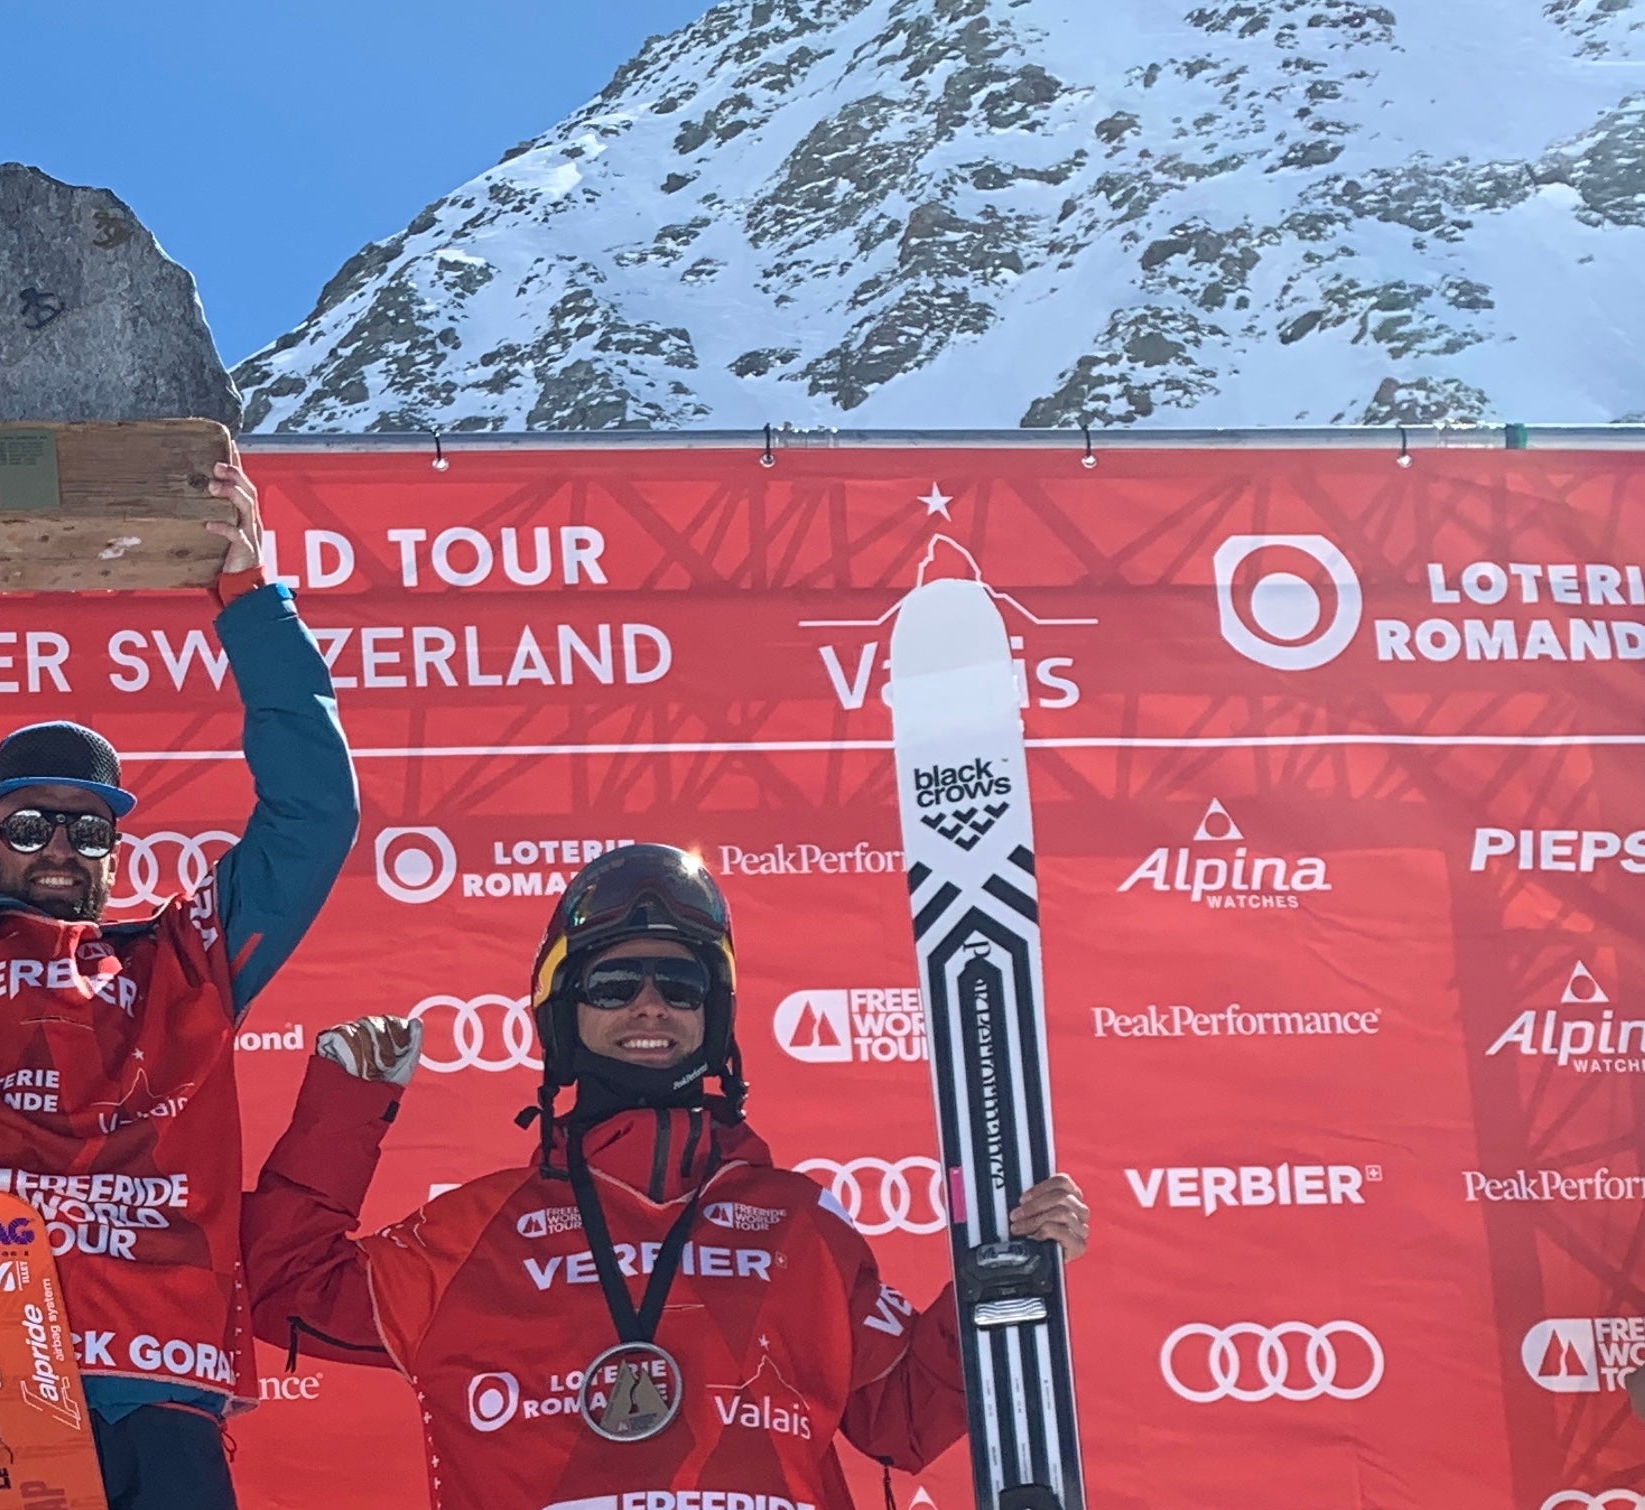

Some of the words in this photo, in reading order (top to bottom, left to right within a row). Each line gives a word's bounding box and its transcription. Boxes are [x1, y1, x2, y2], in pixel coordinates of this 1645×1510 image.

[387, 525, 608, 587] TOUR
[1427, 561, 1645, 605] LOTERI
[108, 624, 672, 692] SWZERLAND
[1374, 618, 1645, 662] ROMAND
[910, 754, 998, 790] black
[912, 771, 1015, 808] crows
[493, 839, 636, 866] LOTERI
[716, 836, 908, 879] PeakPerfor
[1470, 827, 1645, 874] PIEPS
[463, 872, 577, 899] ROMA
[1116, 847, 1332, 905] Alpina
[1206, 894, 1299, 909] WATCHES
[851, 988, 924, 1016] FREE
[851, 1013, 926, 1041] WOR
[1485, 1009, 1645, 1071] Alpin
[852, 1036, 928, 1062] TOU
[1572, 1058, 1645, 1073] WATCH
[16, 1169, 190, 1208] FREERIDE
[1124, 1162, 1365, 1217] VERBIER
[1461, 1167, 1645, 1202] PeakPerfor
[733, 1211, 781, 1226] WORLD
[733, 1219, 770, 1232] TOUR
[51, 1223, 139, 1261] OUR
[42, 1277, 59, 1322] system
[21, 1303, 60, 1402] alpride
[51, 1324, 65, 1362] airbag
[128, 1334, 236, 1385] GORA
[714, 1395, 811, 1440] Valais
